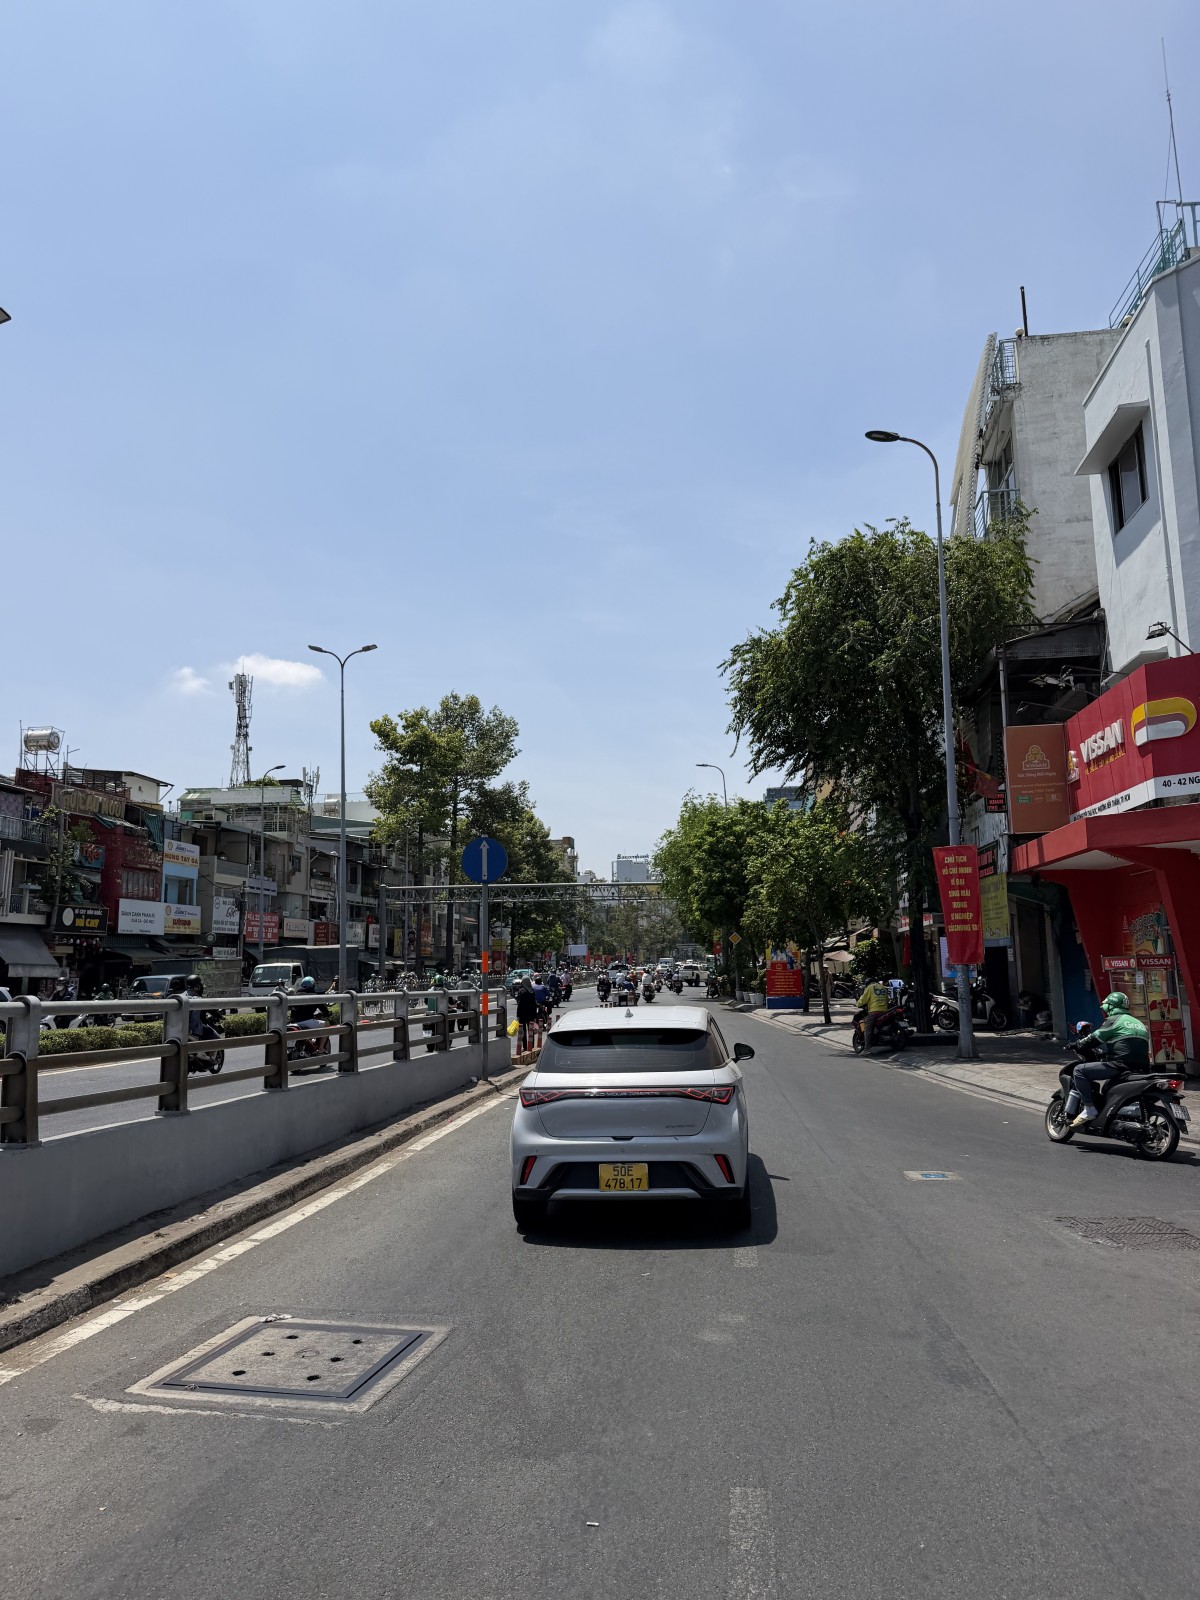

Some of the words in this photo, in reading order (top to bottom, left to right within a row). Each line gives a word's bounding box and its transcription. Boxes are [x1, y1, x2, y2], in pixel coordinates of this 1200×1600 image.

[1080, 719, 1124, 763] VISSAN
[944, 854, 954, 864] CHỦ
[956, 855, 967, 864] TỊCH
[942, 866, 948, 875] HỒ
[949, 866, 958, 874] CHÍ
[961, 888, 970, 896] MÃI
[955, 912, 973, 920] NGHIỆP
[1124, 1020, 1146, 1031] Grab
[613, 1166, 633, 1177] 50E
[605, 1178, 642, 1189] 478.17
